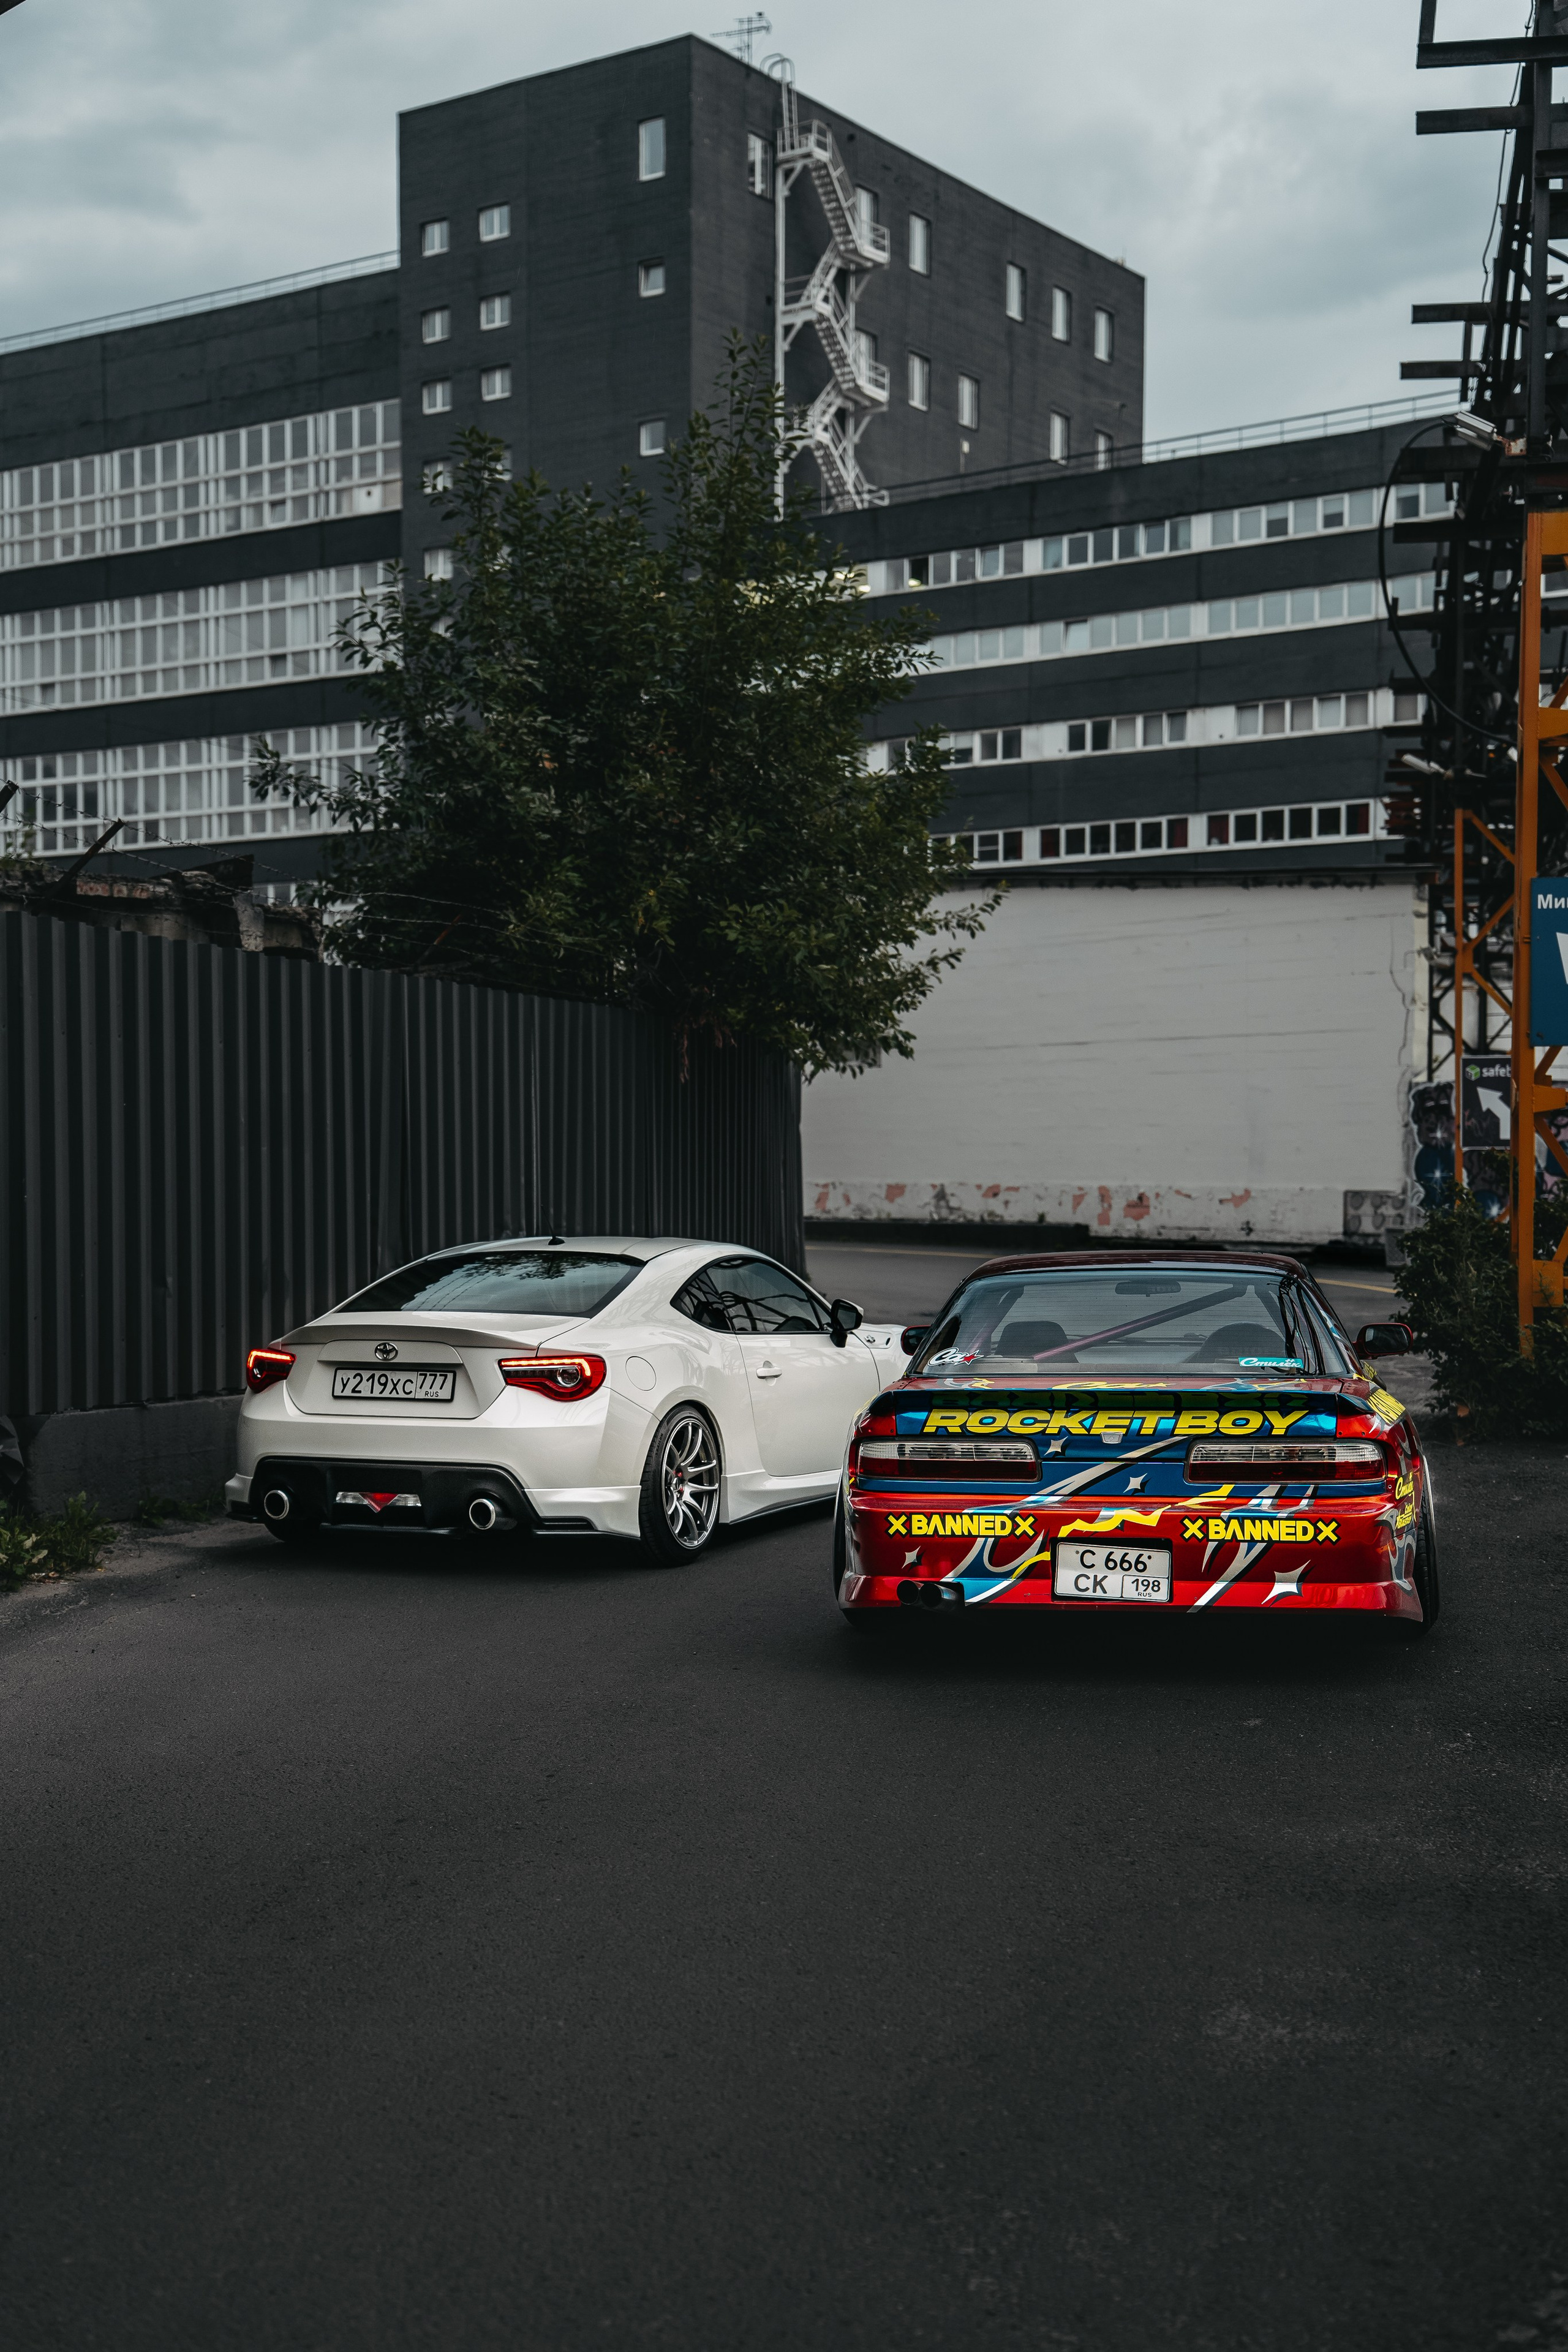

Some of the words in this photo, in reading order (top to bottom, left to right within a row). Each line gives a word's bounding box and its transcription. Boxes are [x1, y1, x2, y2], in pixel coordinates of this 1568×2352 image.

[1538, 894, 1568, 909] Ми
[419, 1373, 448, 1390] 777
[1131, 1578, 1161, 1593] 198
